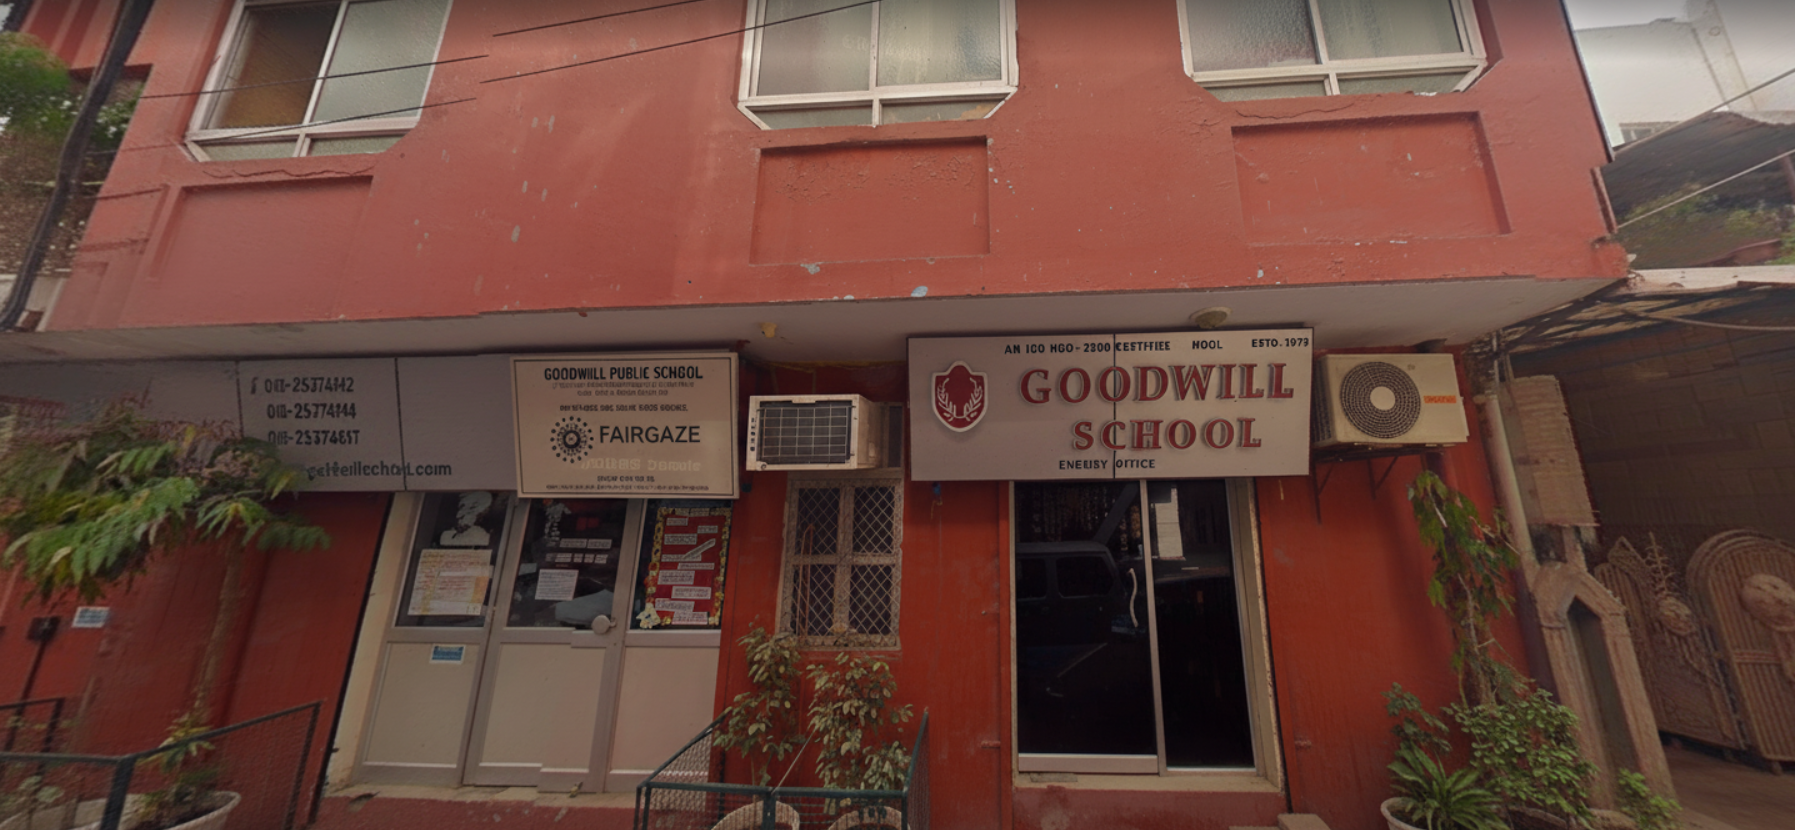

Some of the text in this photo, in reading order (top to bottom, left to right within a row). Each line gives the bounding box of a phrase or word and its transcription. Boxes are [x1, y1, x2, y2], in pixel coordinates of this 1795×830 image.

[1019, 362, 1294, 405] GOODWILL
[599, 425, 701, 444] FAIRGAZE
[1071, 417, 1262, 451] SCHOOL
